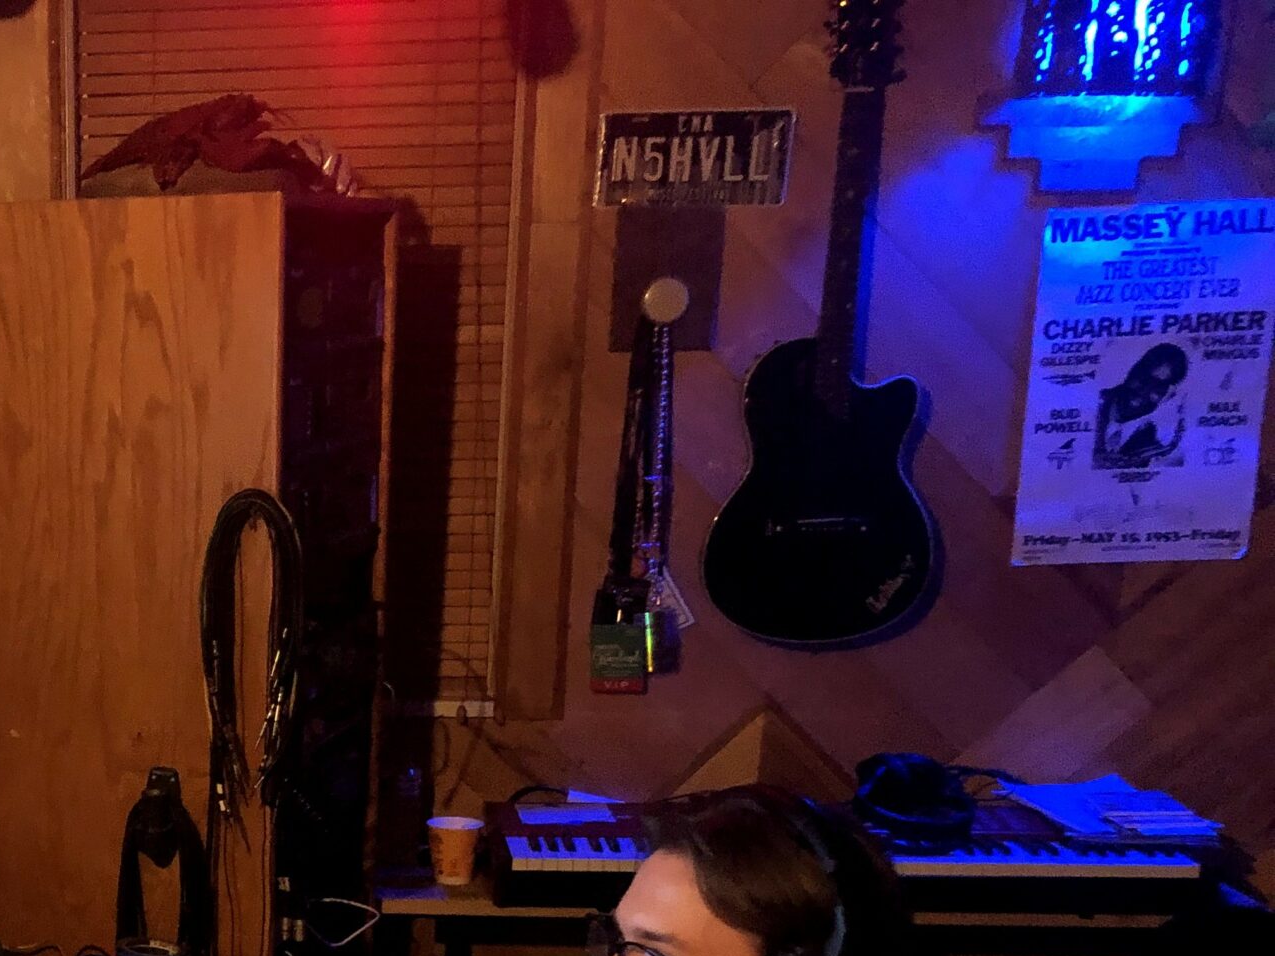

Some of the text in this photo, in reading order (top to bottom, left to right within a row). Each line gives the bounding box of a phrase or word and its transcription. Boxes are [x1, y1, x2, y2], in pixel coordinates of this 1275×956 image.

[1049, 207, 1275, 243] MASSEY HALL
[1102, 256, 1218, 280] THE GREATEST
[1075, 284, 1116, 305] JAZZ
[1120, 280, 1191, 302] CONCERT
[1042, 310, 1267, 341] CHARLIE PARKER
[1051, 341, 1094, 354] DIZZY
[1034, 421, 1093, 435] POWELL
